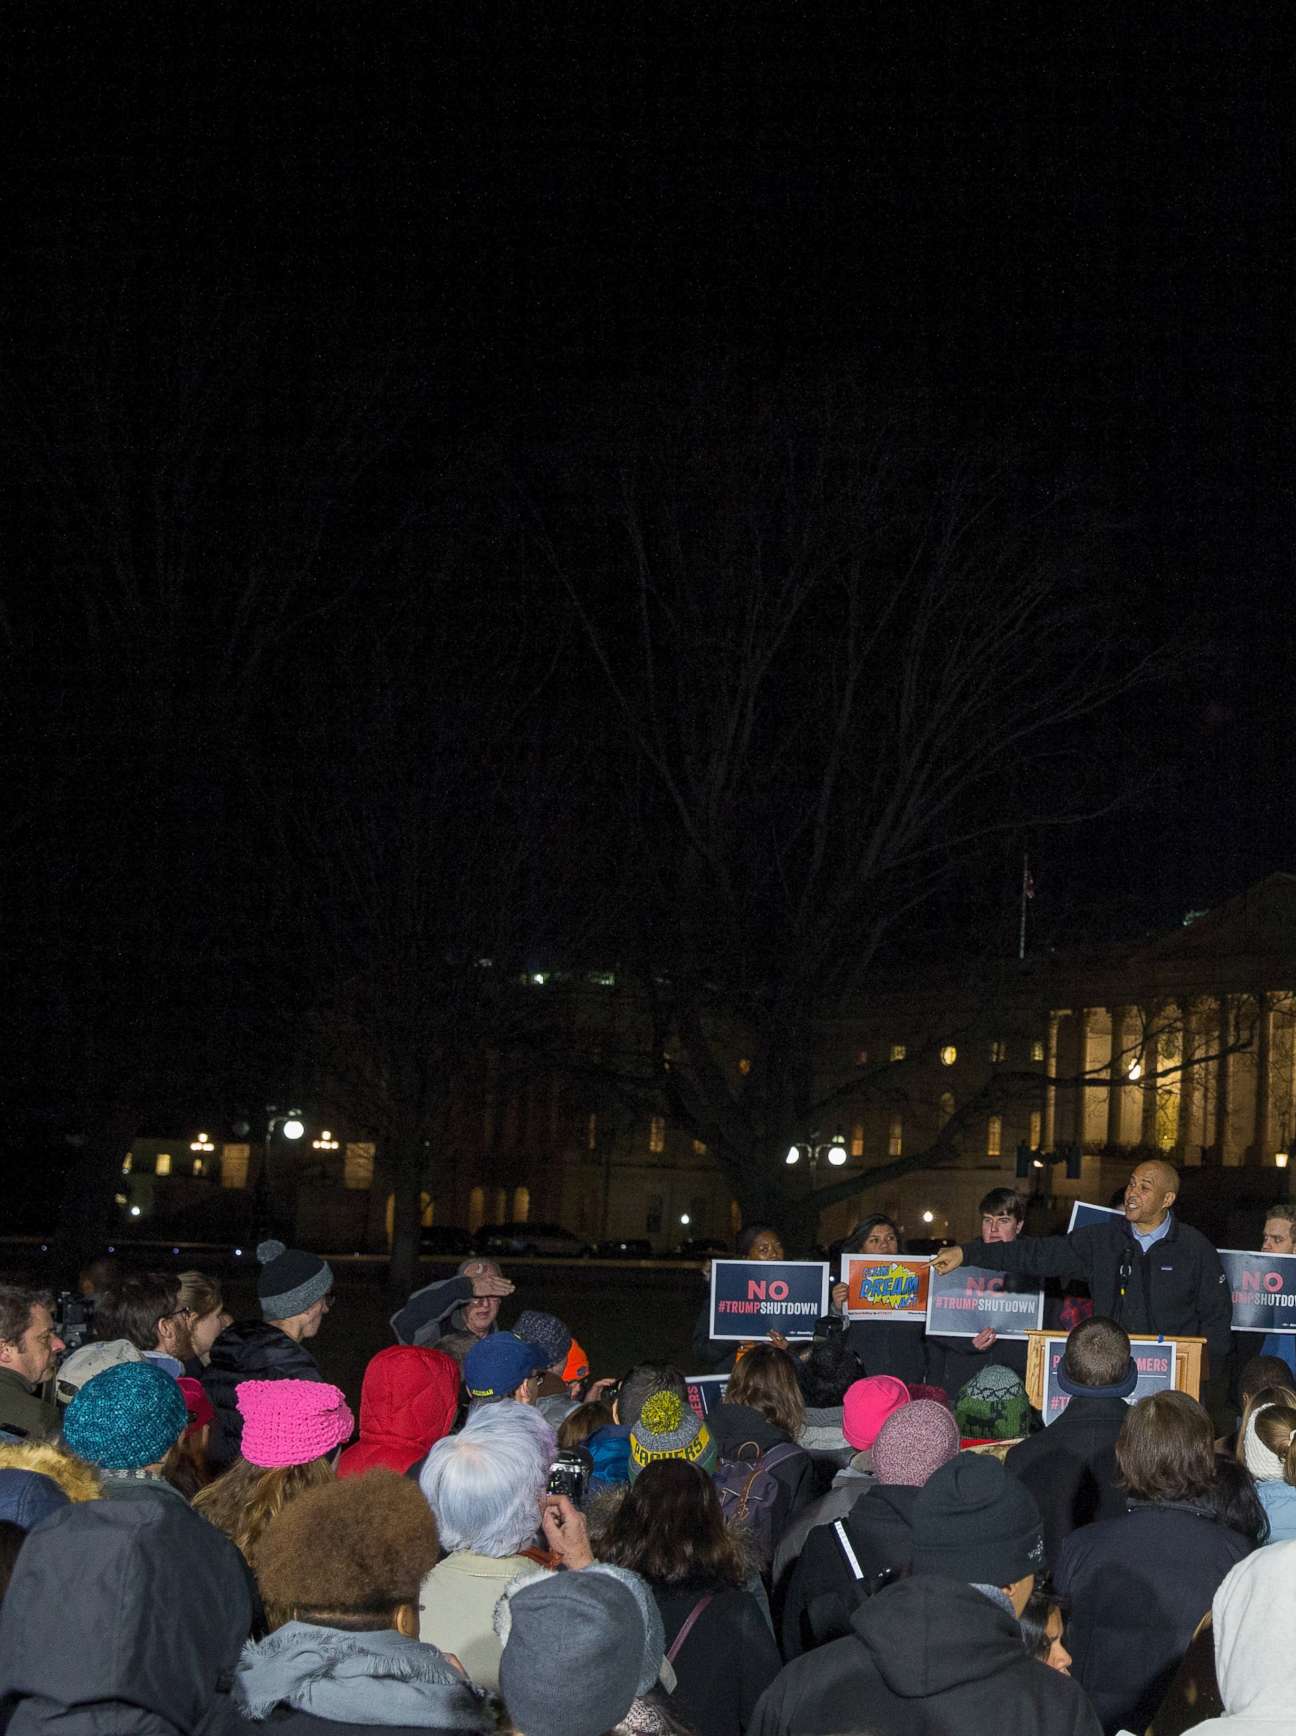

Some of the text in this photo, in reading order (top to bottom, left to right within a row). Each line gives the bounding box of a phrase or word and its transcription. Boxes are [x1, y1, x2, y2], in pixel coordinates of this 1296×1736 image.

[747, 1280, 789, 1301] NO
[861, 1276, 919, 1297] DREAM
[1242, 1271, 1284, 1292] NO
[718, 1300, 818, 1315] #TRUMPSHUTDOWN
[935, 1296, 1036, 1314] #TRUMPSHUTDOWN
[1137, 1355, 1168, 1373] MERS
